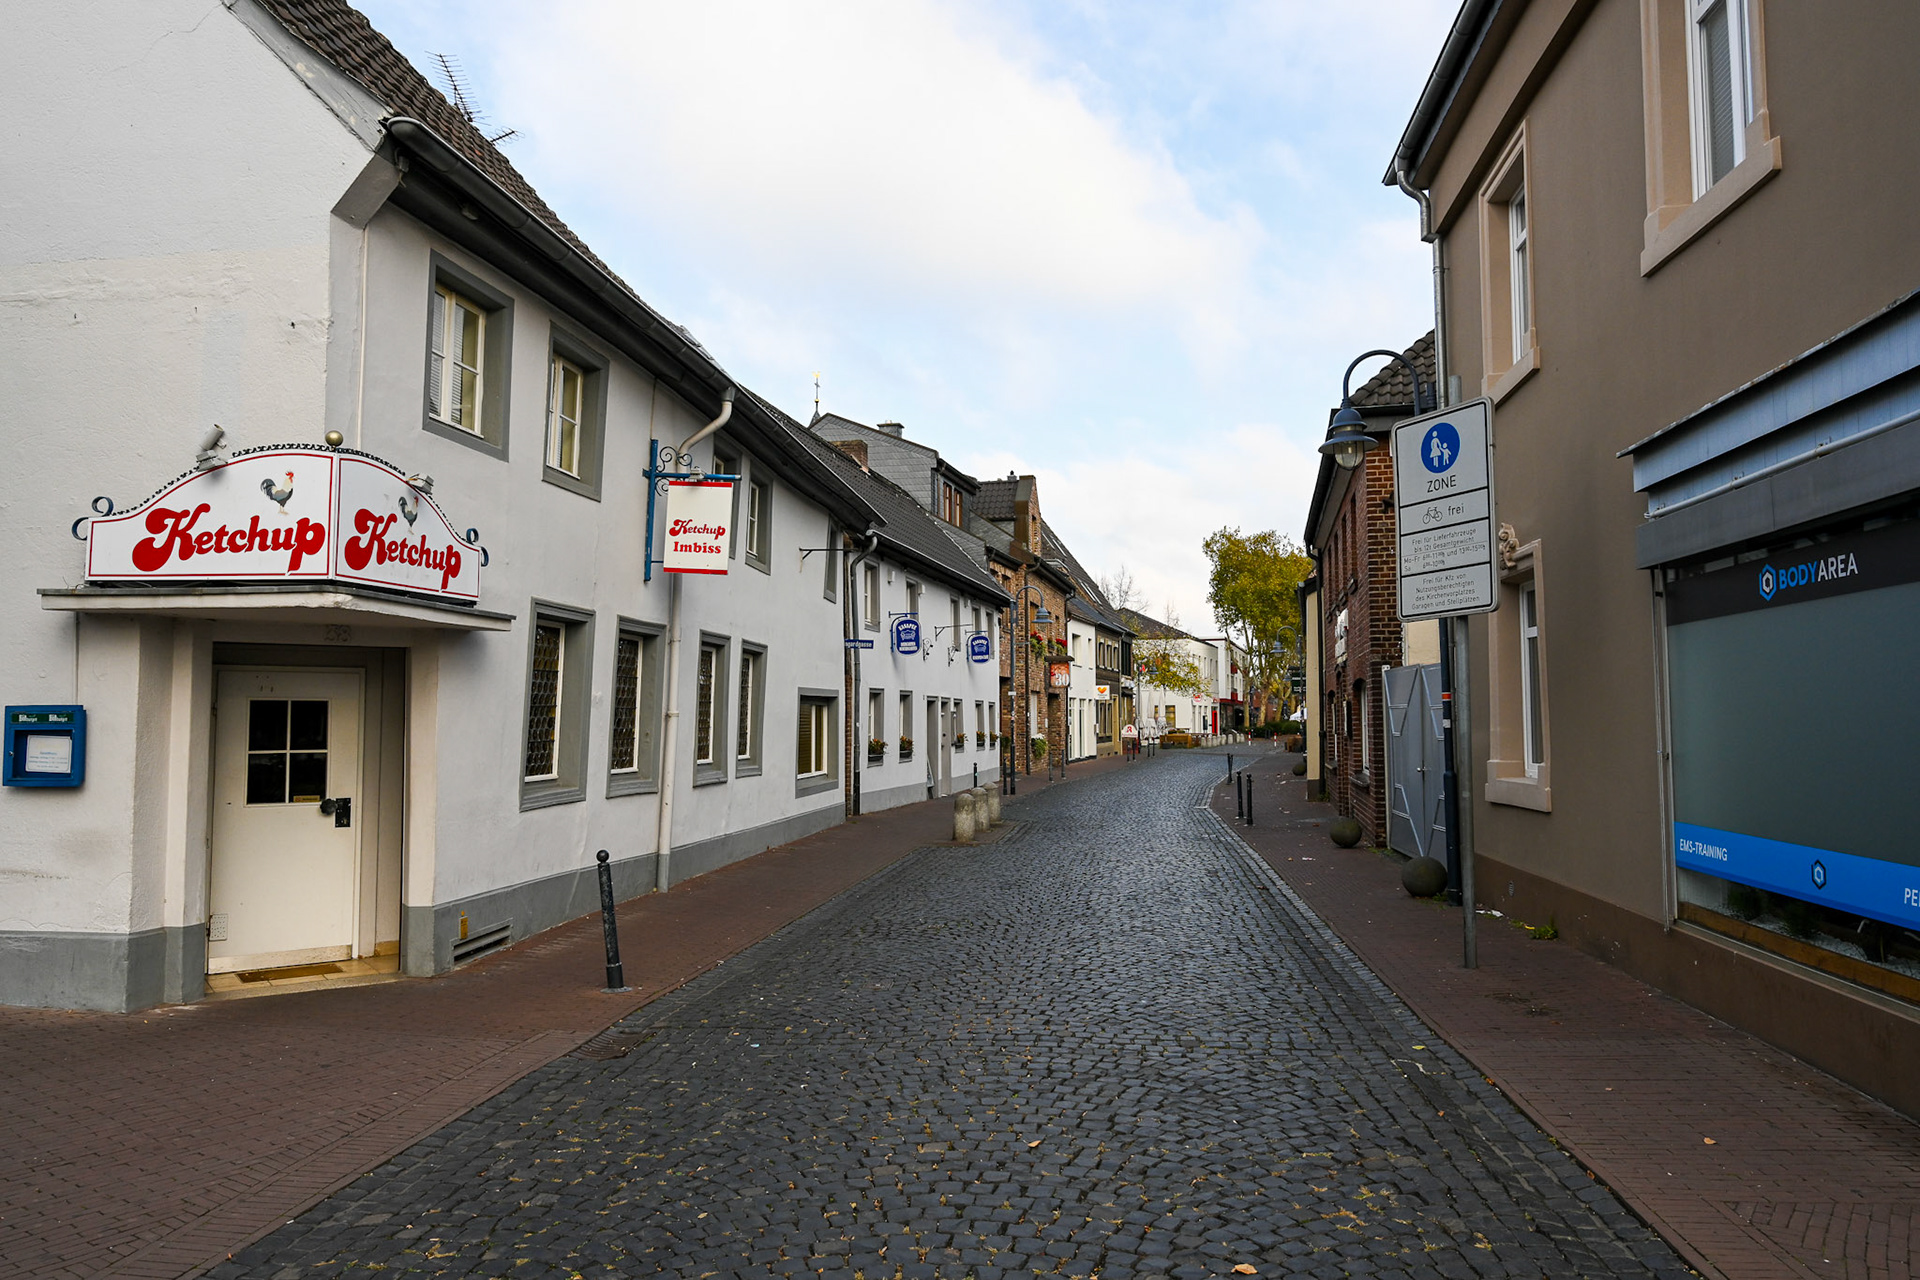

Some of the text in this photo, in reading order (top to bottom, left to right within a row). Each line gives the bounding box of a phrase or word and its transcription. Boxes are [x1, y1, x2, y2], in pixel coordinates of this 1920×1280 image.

[1427, 474, 1457, 493] ZONE
[1448, 503, 1464, 516] frei
[669, 518, 726, 540] Ketchup
[1412, 538, 1421, 546] Frei
[1433, 528, 1476, 542] Lieferfahrzeuge
[132, 503, 326, 572] Ketchup
[1433, 536, 1475, 550] Gesamtgewicht
[344, 508, 462, 590] Ketchup
[673, 541, 721, 554] Imbiss
[1446, 548, 1458, 557] und
[1778, 552, 1859, 590] BODYAREA
[1415, 580, 1475, 594] Nutzungsberechtigten
[1423, 577, 1433, 585] Frei
[1411, 602, 1434, 611] Garagen
[1447, 596, 1480, 606] Stellplätzen
[1415, 594, 1425, 602] des
[1680, 838, 1728, 861] EMS-TRAINING
[1904, 887, 1920, 908] PE
